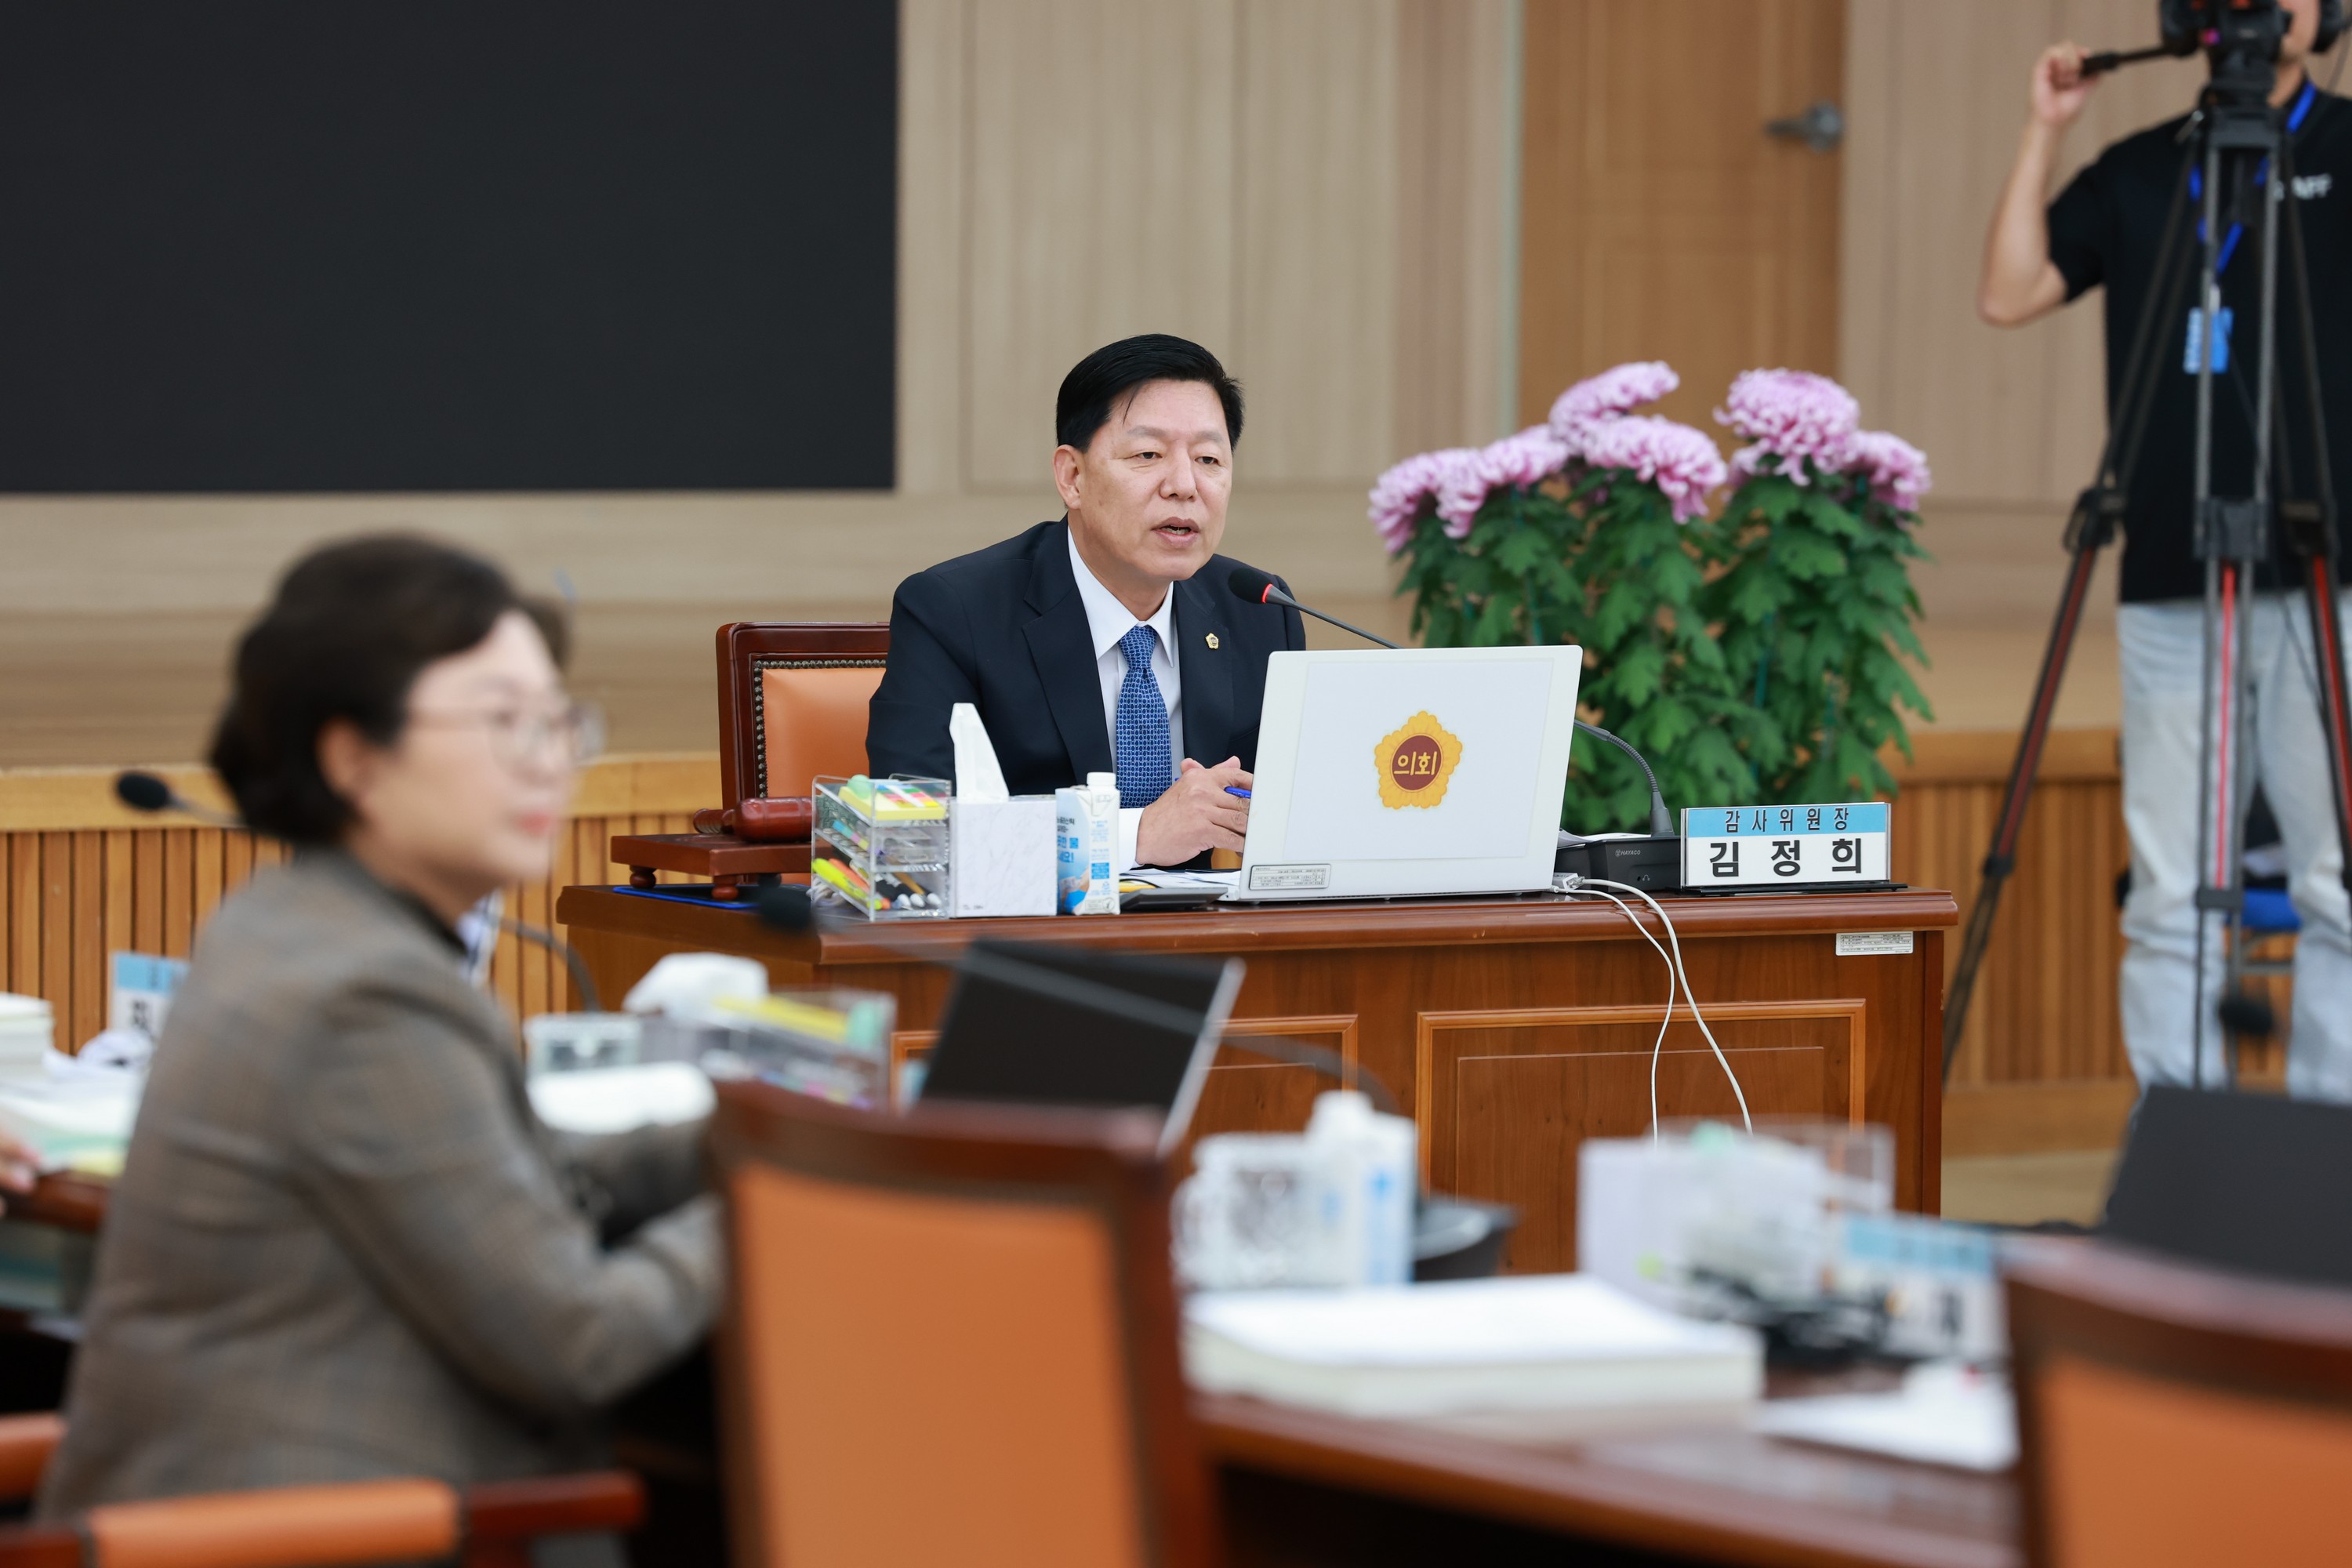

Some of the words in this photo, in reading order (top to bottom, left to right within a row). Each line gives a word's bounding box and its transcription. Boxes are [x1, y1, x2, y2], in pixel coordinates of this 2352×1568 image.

[1393, 750, 1438, 776] 의회
[1725, 807, 1849, 833] 감사위원장
[1709, 837, 1862, 878] 김정희
